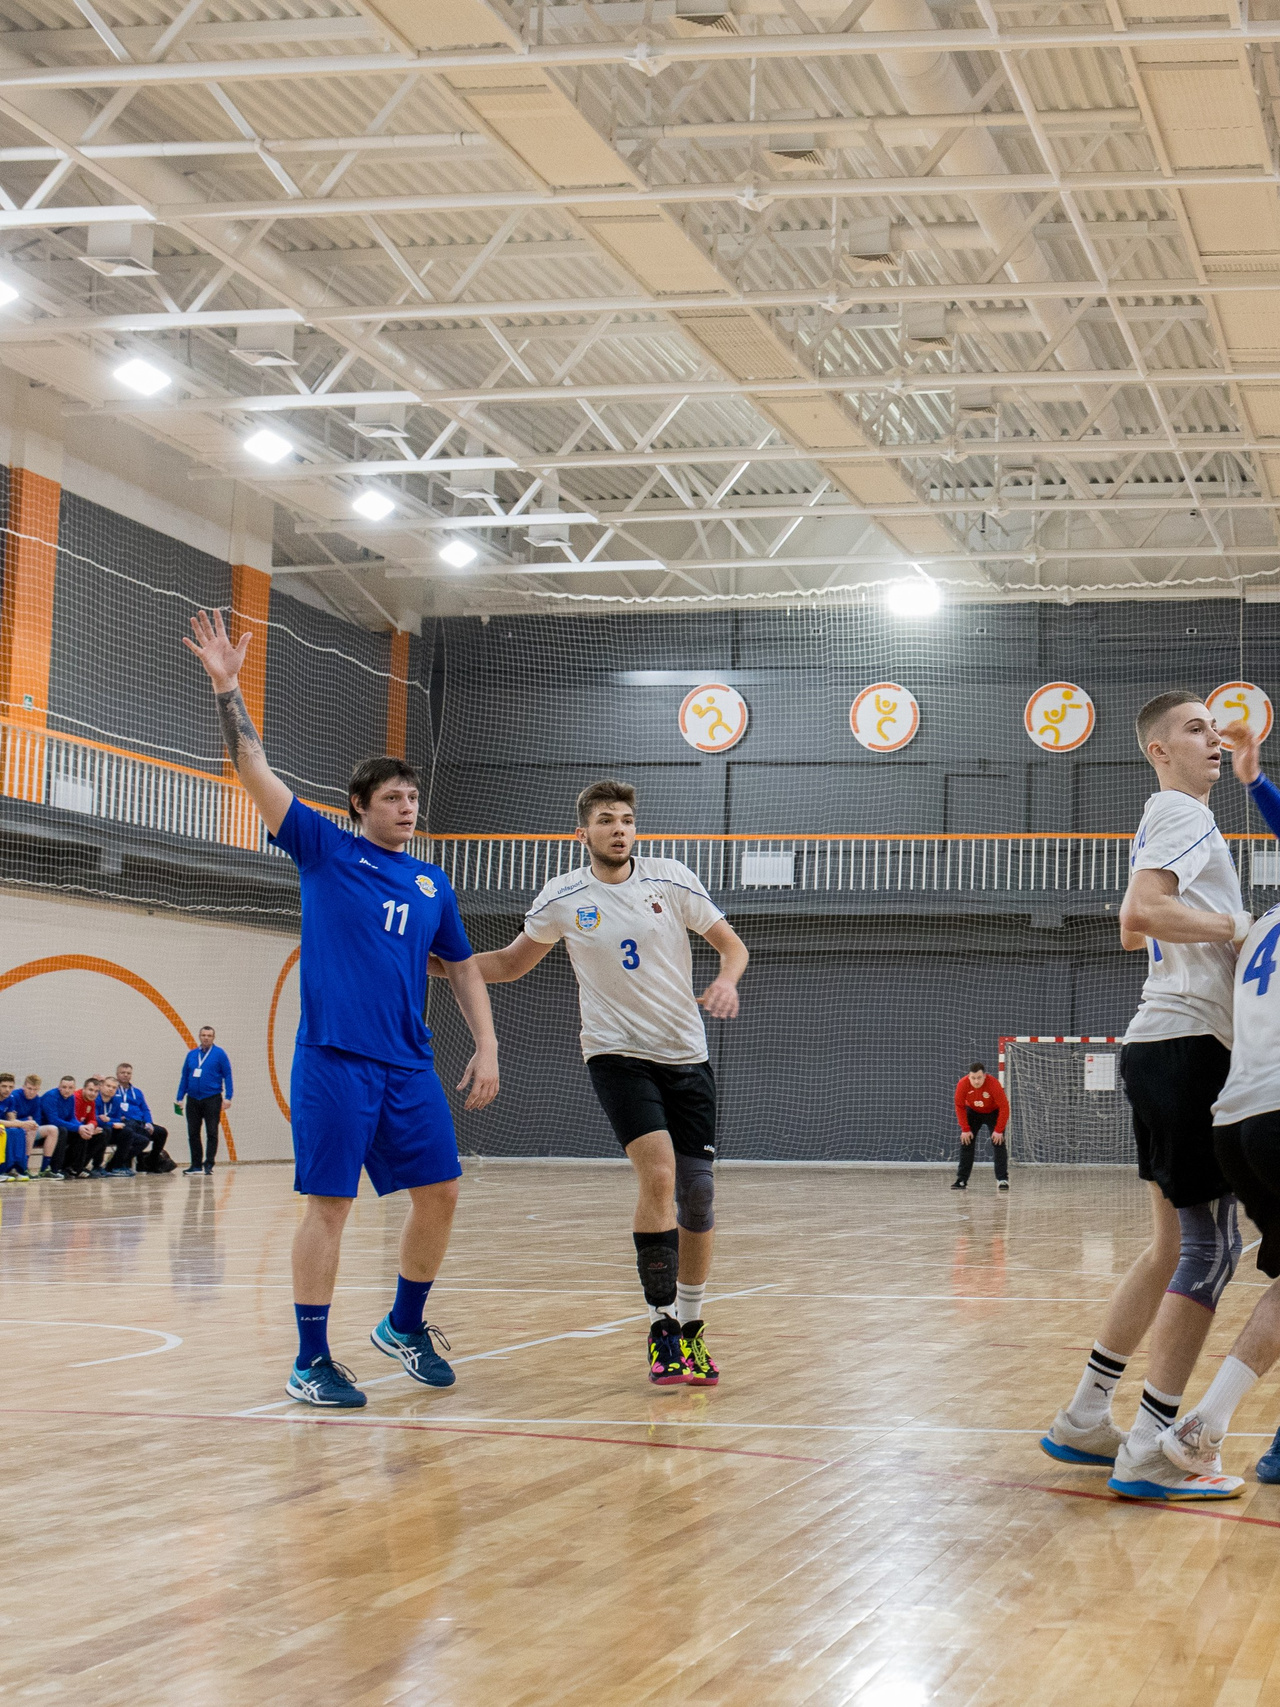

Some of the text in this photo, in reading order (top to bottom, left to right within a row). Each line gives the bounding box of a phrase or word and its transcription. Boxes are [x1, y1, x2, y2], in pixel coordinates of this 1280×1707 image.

[557, 879, 584, 895] uhlsport
[382, 899, 410, 936] 11
[620, 938, 641, 971] 3
